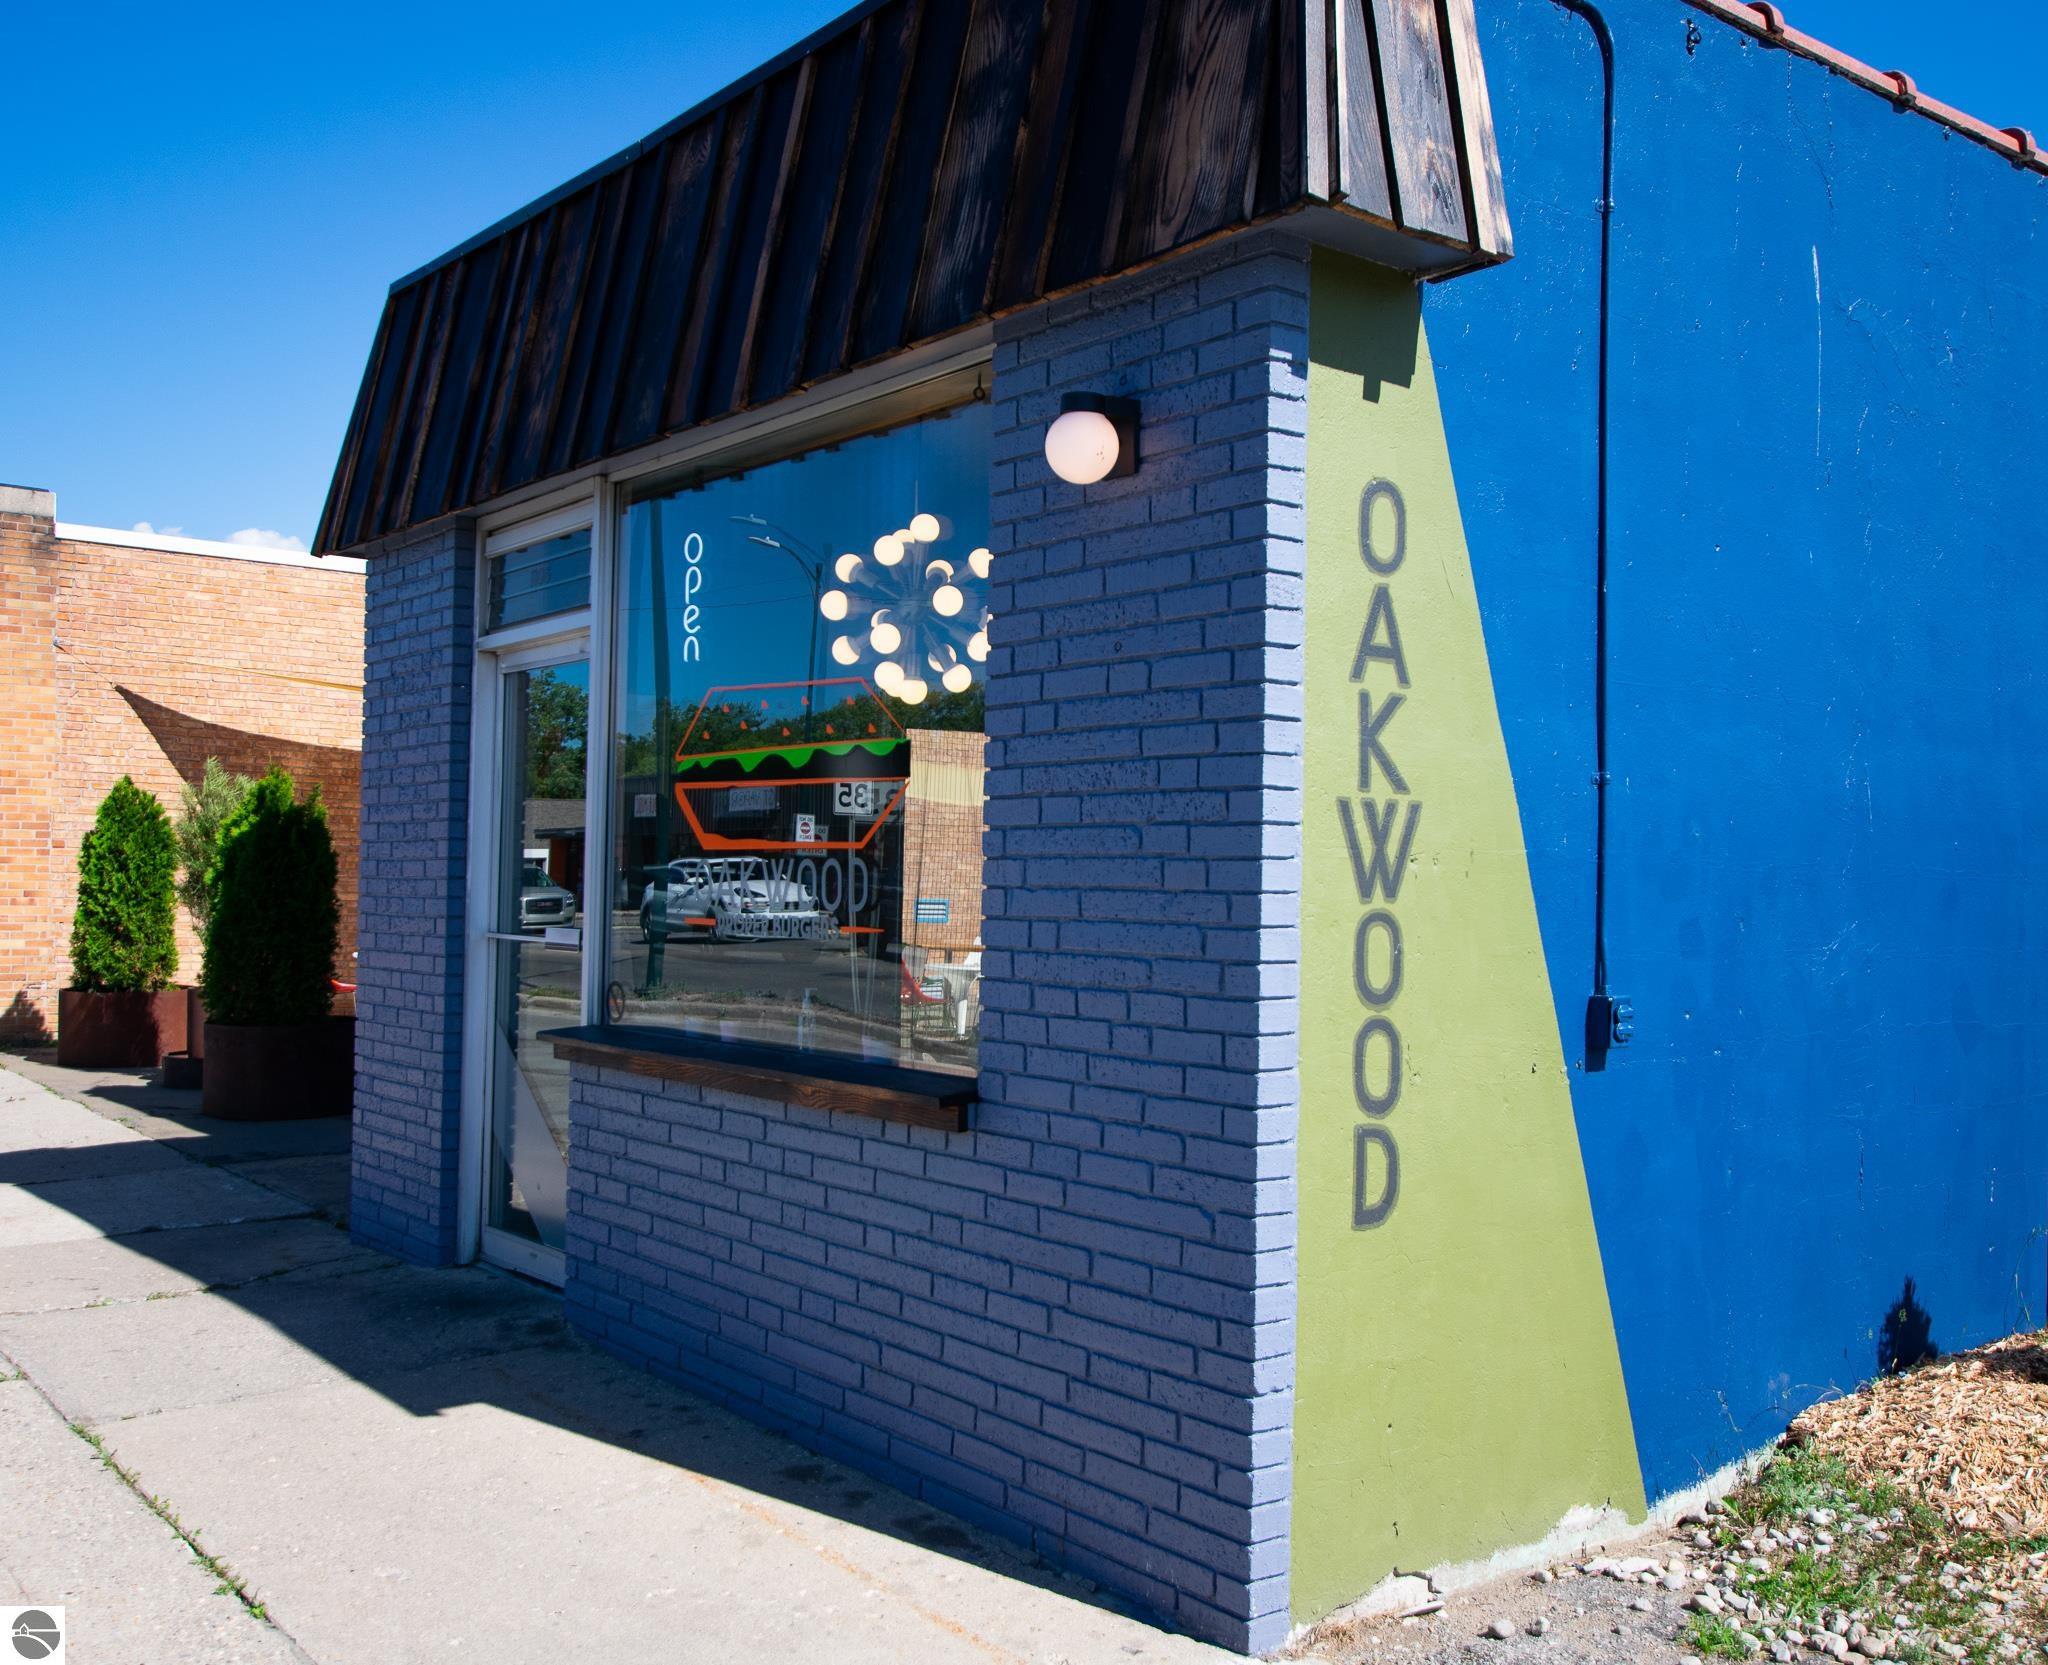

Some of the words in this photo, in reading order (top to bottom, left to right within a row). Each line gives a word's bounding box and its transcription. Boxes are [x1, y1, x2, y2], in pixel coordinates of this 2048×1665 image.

[1337, 477, 1421, 1232] OAKWOOD
[695, 858, 868, 913] OAKWOOD
[717, 913, 769, 937] PROPER
[772, 914, 839, 942] BURGERS
